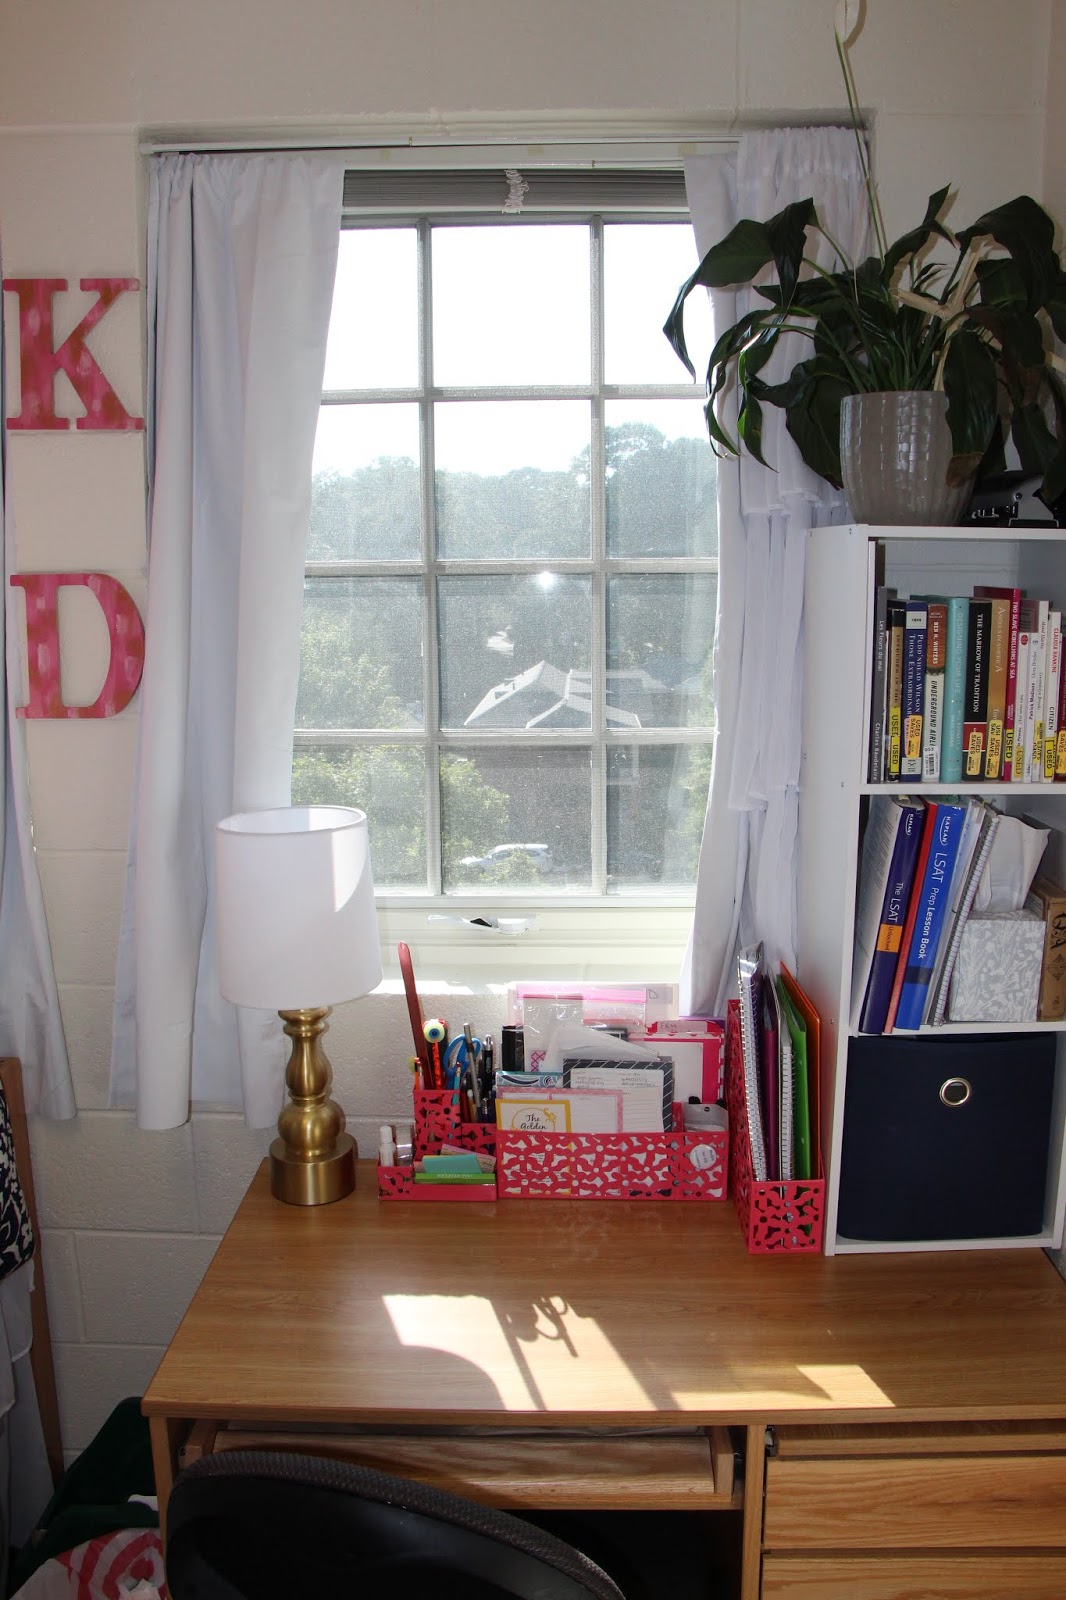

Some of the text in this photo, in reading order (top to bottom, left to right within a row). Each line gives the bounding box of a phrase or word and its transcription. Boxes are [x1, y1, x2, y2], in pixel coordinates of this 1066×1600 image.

[3, 278, 144, 430] K
[10, 573, 145, 718] D
[877, 651, 884, 660] du
[954, 612, 964, 694] DESIGNING YOUR LIFE
[975, 629, 983, 662] MARROW
[1010, 630, 1018, 661] REBELLIONS
[975, 662, 982, 673] OF
[1051, 650, 1059, 673] RANKINE
[930, 680, 938, 729] UNDERGROUND
[973, 674, 981, 713] TRADITION
[929, 729, 937, 747] AIRLI
[988, 738, 996, 758] SAVES
[872, 747, 880, 781] Baudelaire
[1015, 750, 1023, 775] USED
[888, 813, 914, 923] KAPLAN The LSAT
[918, 816, 951, 959] KAPLAN LSAT Prep Lesson Book
[885, 926, 894, 951] Unlocked
[520, 1122, 547, 1131] Golden
[525, 1113, 541, 1122] The
